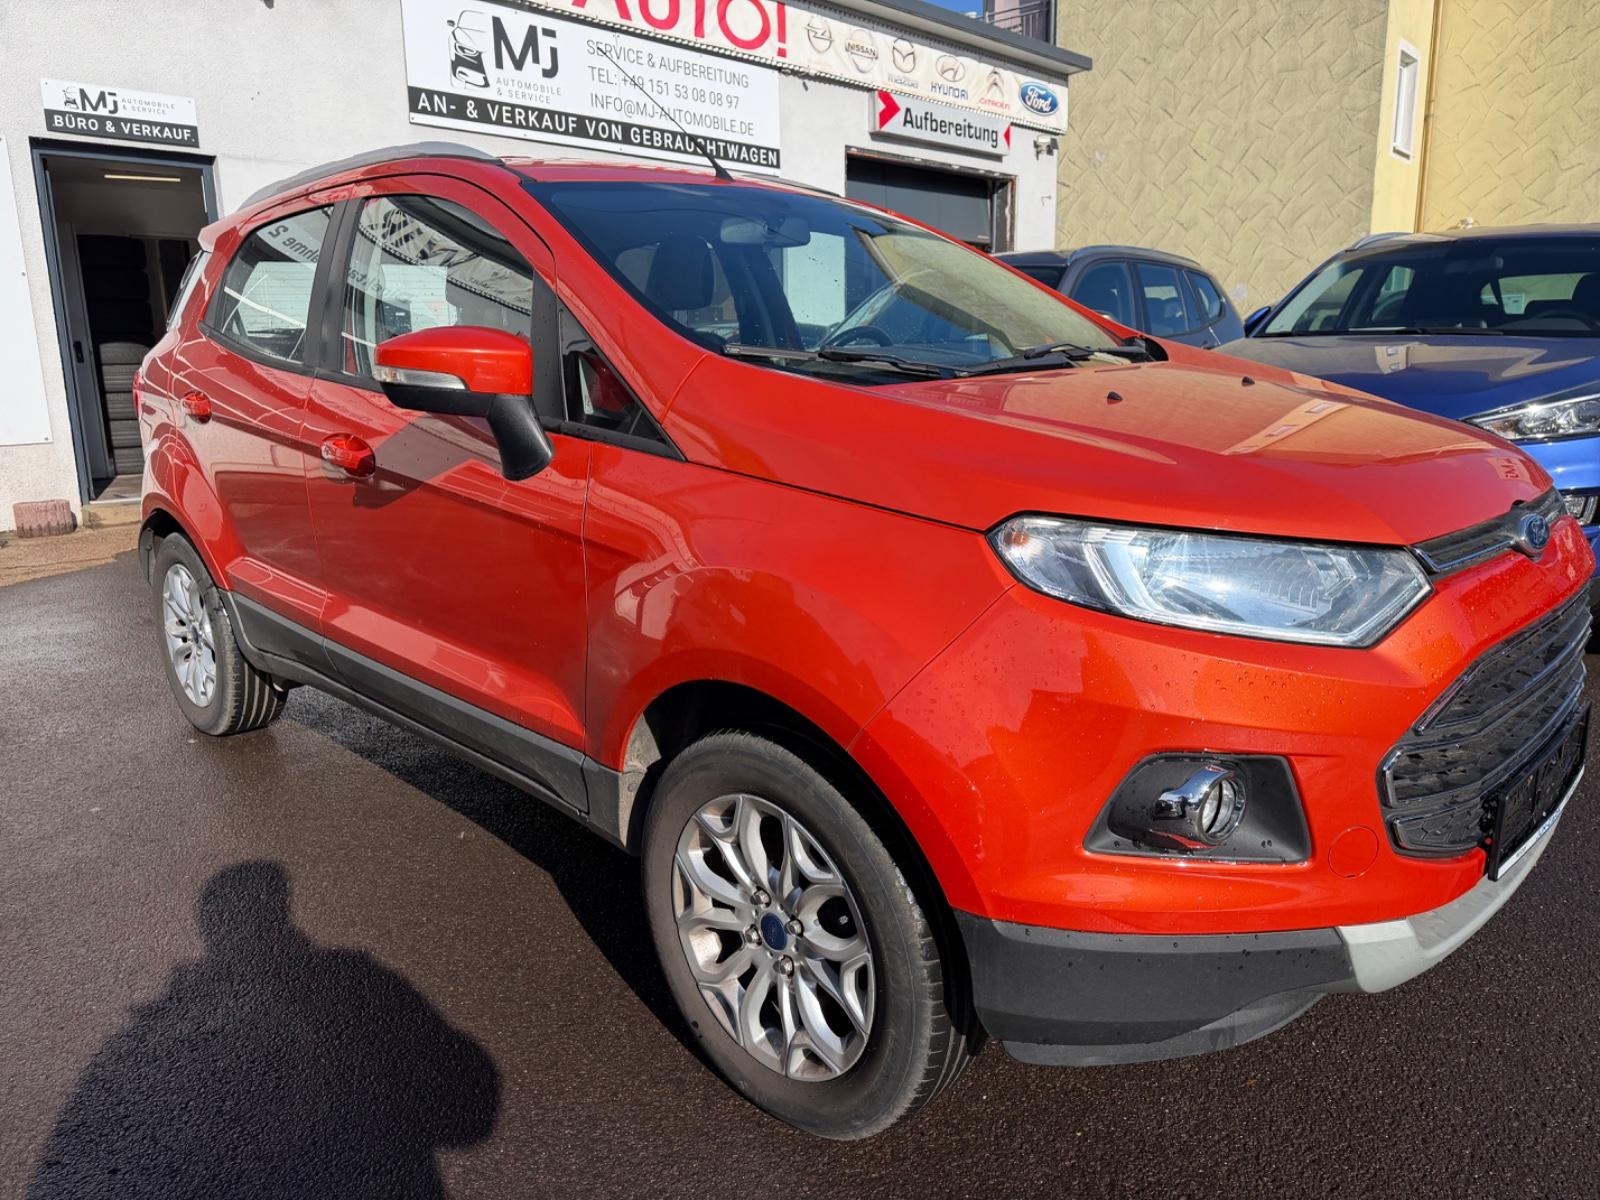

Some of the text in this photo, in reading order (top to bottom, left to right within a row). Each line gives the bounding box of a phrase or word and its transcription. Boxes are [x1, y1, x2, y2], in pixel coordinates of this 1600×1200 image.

[571, 0, 788, 58] UO!
[847, 41, 877, 57] NISSAN
[586, 39, 749, 88] SERVICE & AUFBEREITUNG
[496, 76, 561, 96] AUTOMOBILE
[496, 87, 551, 104] & SERVICE
[588, 65, 740, 110] TEL: +49 151 53 08 08 97
[930, 82, 969, 101] HYUNDAI
[1025, 84, 1052, 112] Ford
[121, 98, 176, 110] AUTOMOBILE
[131, 105, 167, 116] SERVICE
[590, 92, 755, 137] INFO@MJ-AUTOMOBILE.DE
[54, 113, 192, 141] BÜRO & VERKAUF
[417, 92, 778, 166] AN- & VERKAUF VON GEBRAUCHTWAGEN
[903, 107, 999, 149] Aufbereitung
